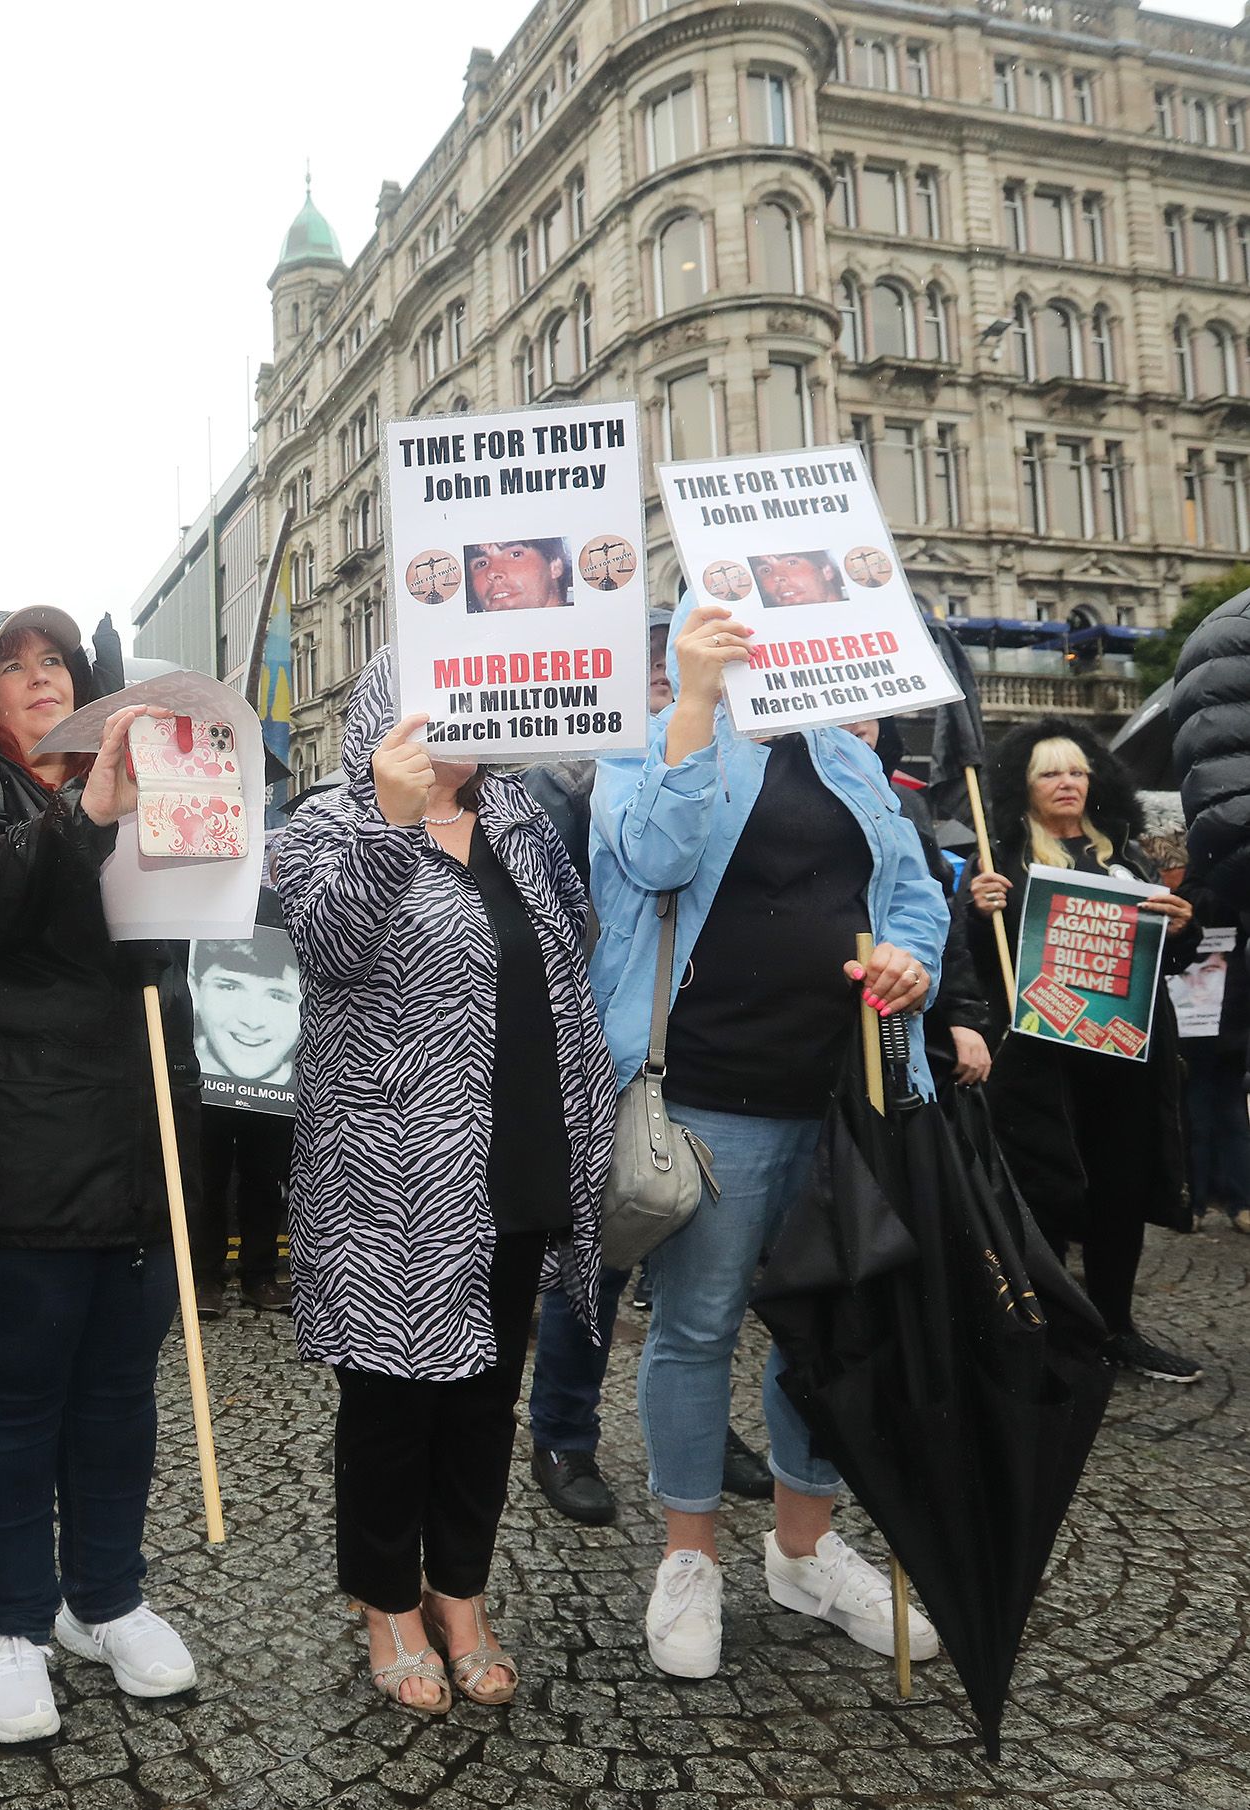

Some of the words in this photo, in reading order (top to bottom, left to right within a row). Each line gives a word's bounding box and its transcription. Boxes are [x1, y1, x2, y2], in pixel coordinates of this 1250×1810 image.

[399, 435, 469, 468] TIME
[473, 428, 528, 463] FOR
[532, 418, 626, 457] TRUTH
[423, 470, 492, 503] John
[499, 462, 607, 495] Murray
[674, 475, 731, 501] TIME
[734, 470, 778, 494] FOR
[781, 461, 857, 489] TRUTH
[701, 502, 761, 527] John
[762, 494, 850, 520] Murray
[438, 566, 458, 577] TRUTH
[612, 552, 633, 564] TRUTH
[750, 629, 899, 670] MURDERED
[433, 647, 613, 690] MURDERED
[765, 673, 786, 692] IN
[790, 657, 894, 688] MILLTOWN
[449, 692, 475, 714] IN
[480, 685, 598, 713] MILLTOWN
[751, 691, 819, 716] March
[820, 680, 869, 706] 16th
[871, 674, 927, 698] 1988
[425, 717, 501, 743] March
[507, 715, 558, 740] 16th
[564, 711, 623, 735] 1988
[1065, 896, 1123, 920] STAND
[1052, 914, 1131, 939] AGAINST
[1048, 928, 1130, 959] BRITAIN'S
[1054, 947, 1089, 970] BILL
[1092, 955, 1119, 974] OF
[1053, 965, 1115, 993] SHAME
[1047, 983, 1081, 1012] PROTECT
[1113, 1020, 1142, 1045] PROTECT
[238, 1085, 295, 1103] GILMOUR
